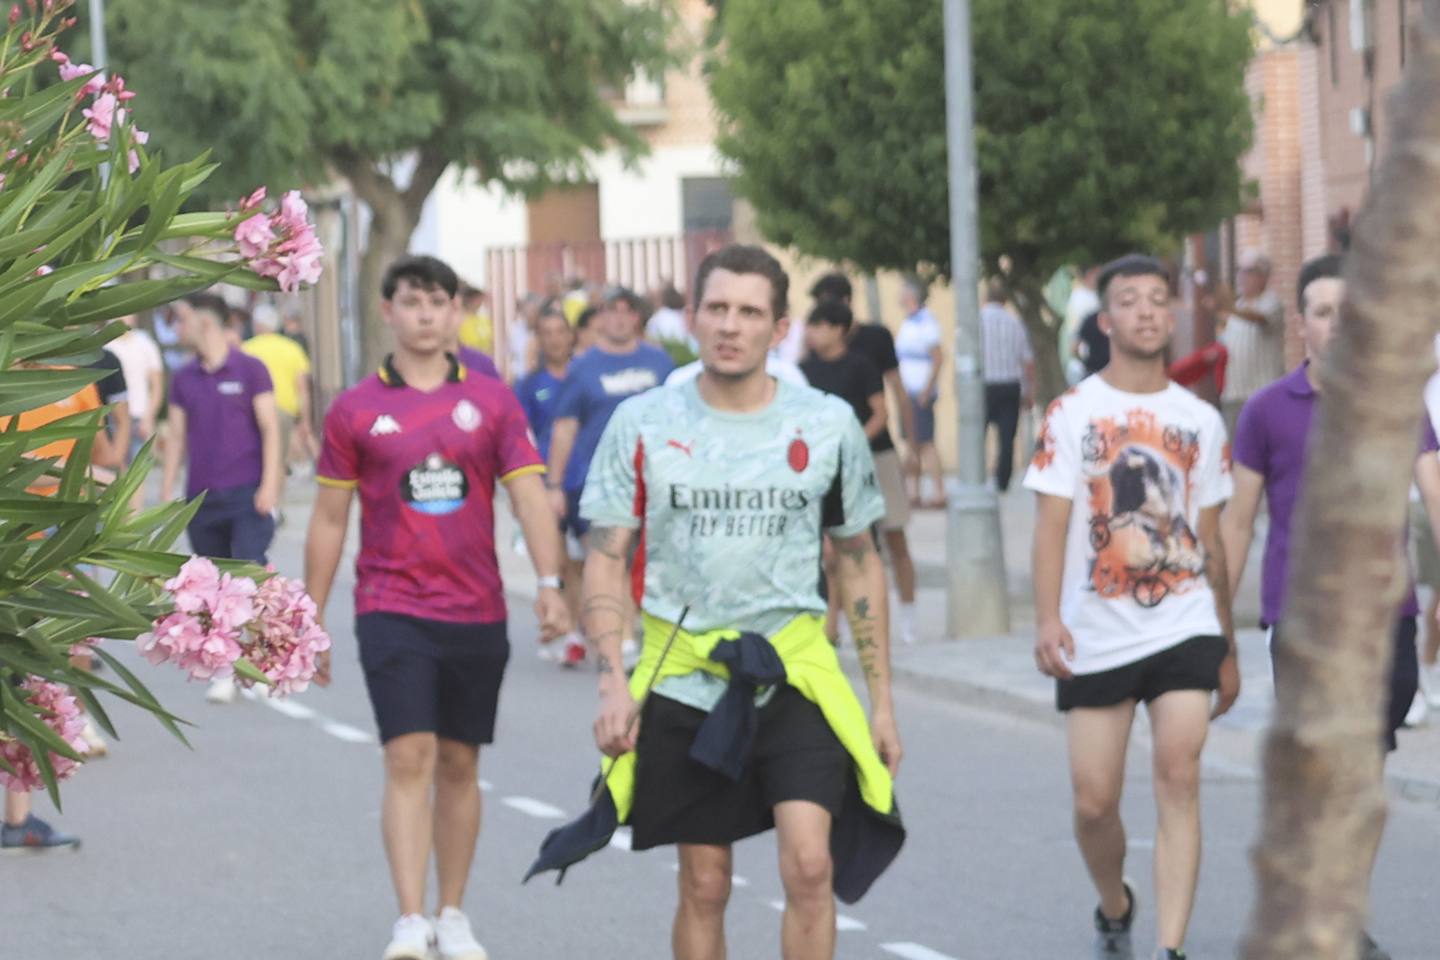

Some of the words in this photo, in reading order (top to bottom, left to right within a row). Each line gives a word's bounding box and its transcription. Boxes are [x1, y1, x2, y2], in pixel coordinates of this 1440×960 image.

[669, 483, 808, 510] Emirates
[690, 515, 718, 536] FLY
[724, 514, 787, 536] BETTER
